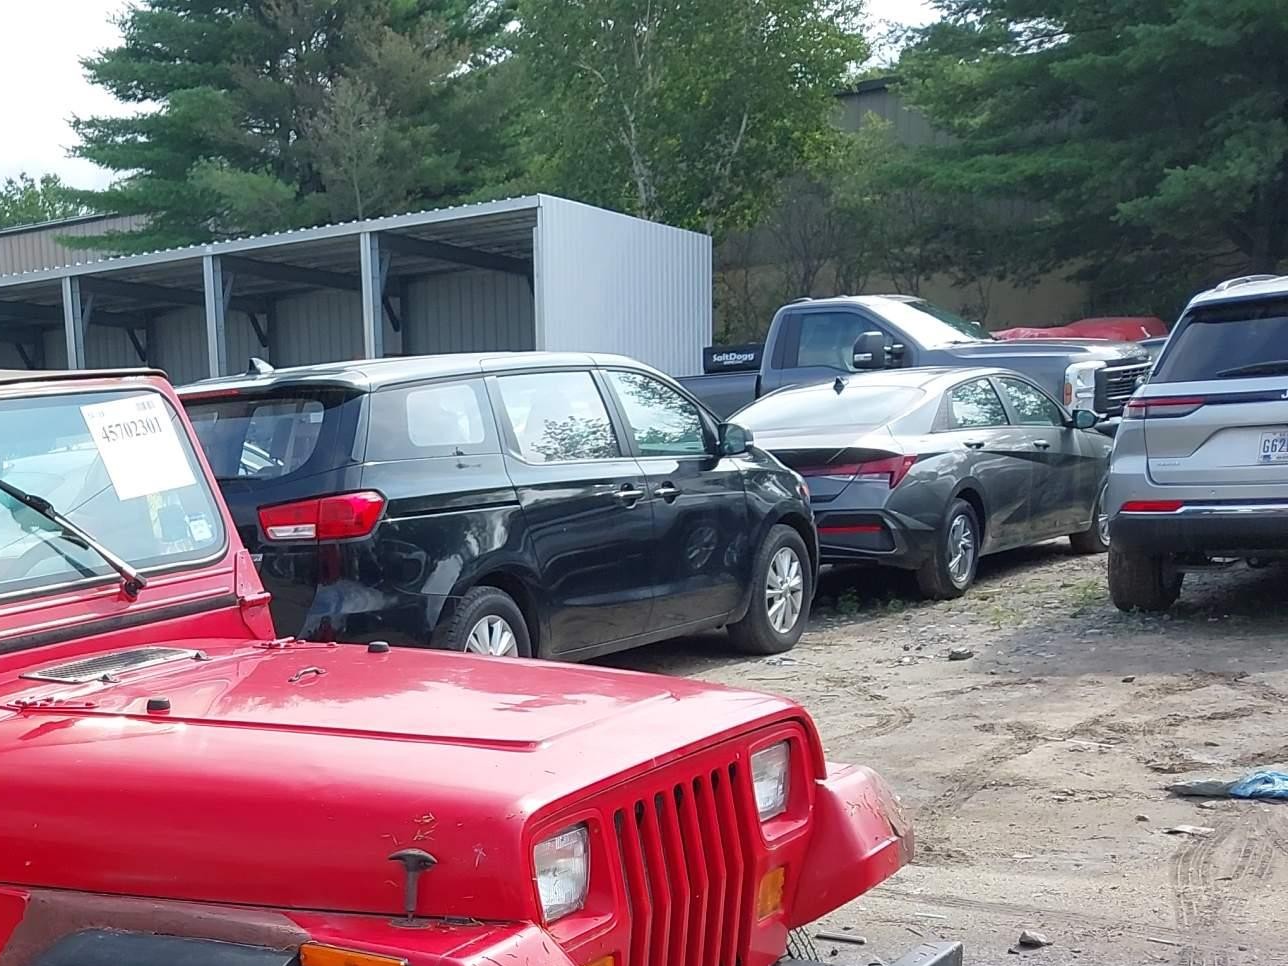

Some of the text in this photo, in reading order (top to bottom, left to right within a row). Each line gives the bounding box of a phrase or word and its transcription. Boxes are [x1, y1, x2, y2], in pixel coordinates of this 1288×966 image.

[712, 352, 754, 362] SaltDogg
[101, 416, 162, 442] 45702301
[1263, 438, 1288, 454] G62
